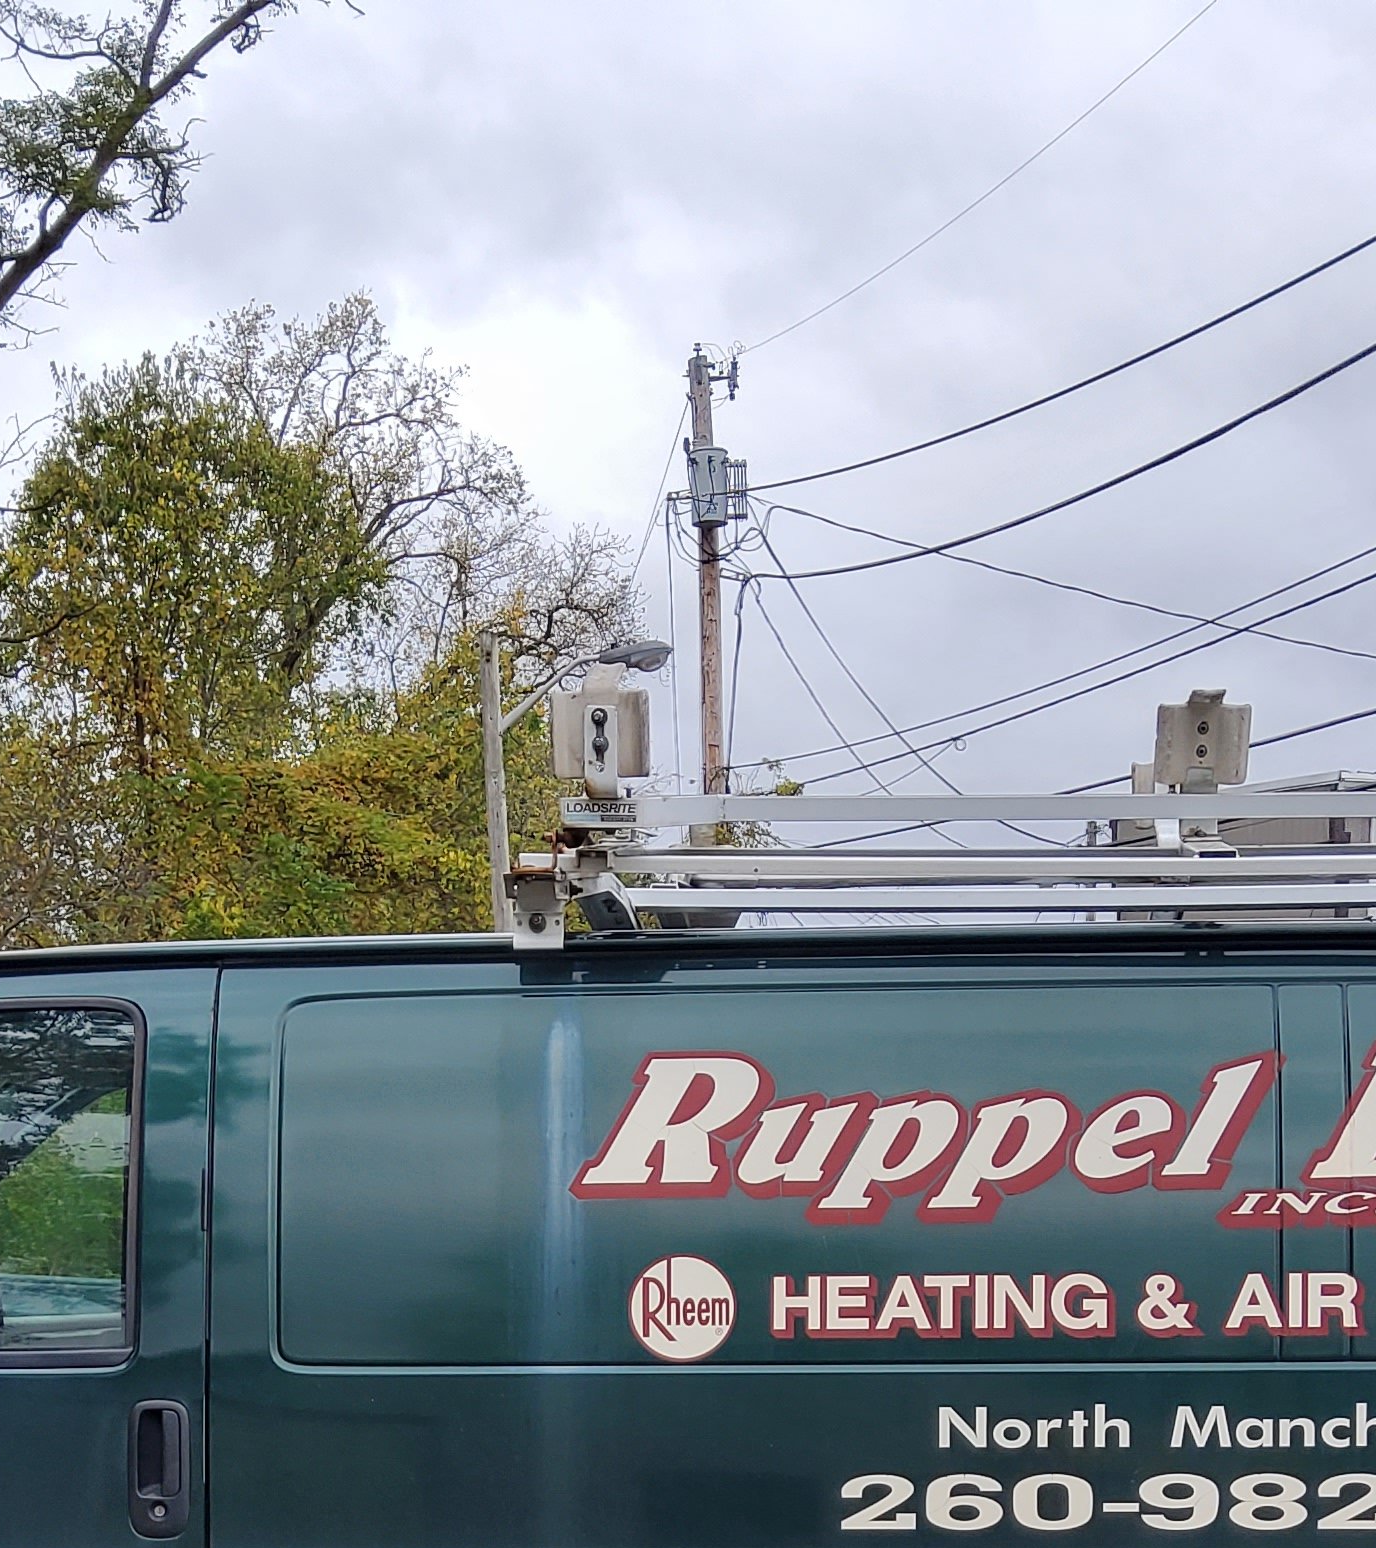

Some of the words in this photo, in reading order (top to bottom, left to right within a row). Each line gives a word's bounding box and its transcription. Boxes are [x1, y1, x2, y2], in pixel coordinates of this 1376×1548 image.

[566, 802, 637, 814] LOADSRITE
[576, 1056, 1269, 1212] Ruppel
[641, 1257, 731, 1342] Rheem
[772, 1273, 1110, 1332] HEATING
[1137, 1273, 1195, 1331] &
[1224, 1271, 1360, 1330] AIR
[938, 1403, 1131, 1449] North
